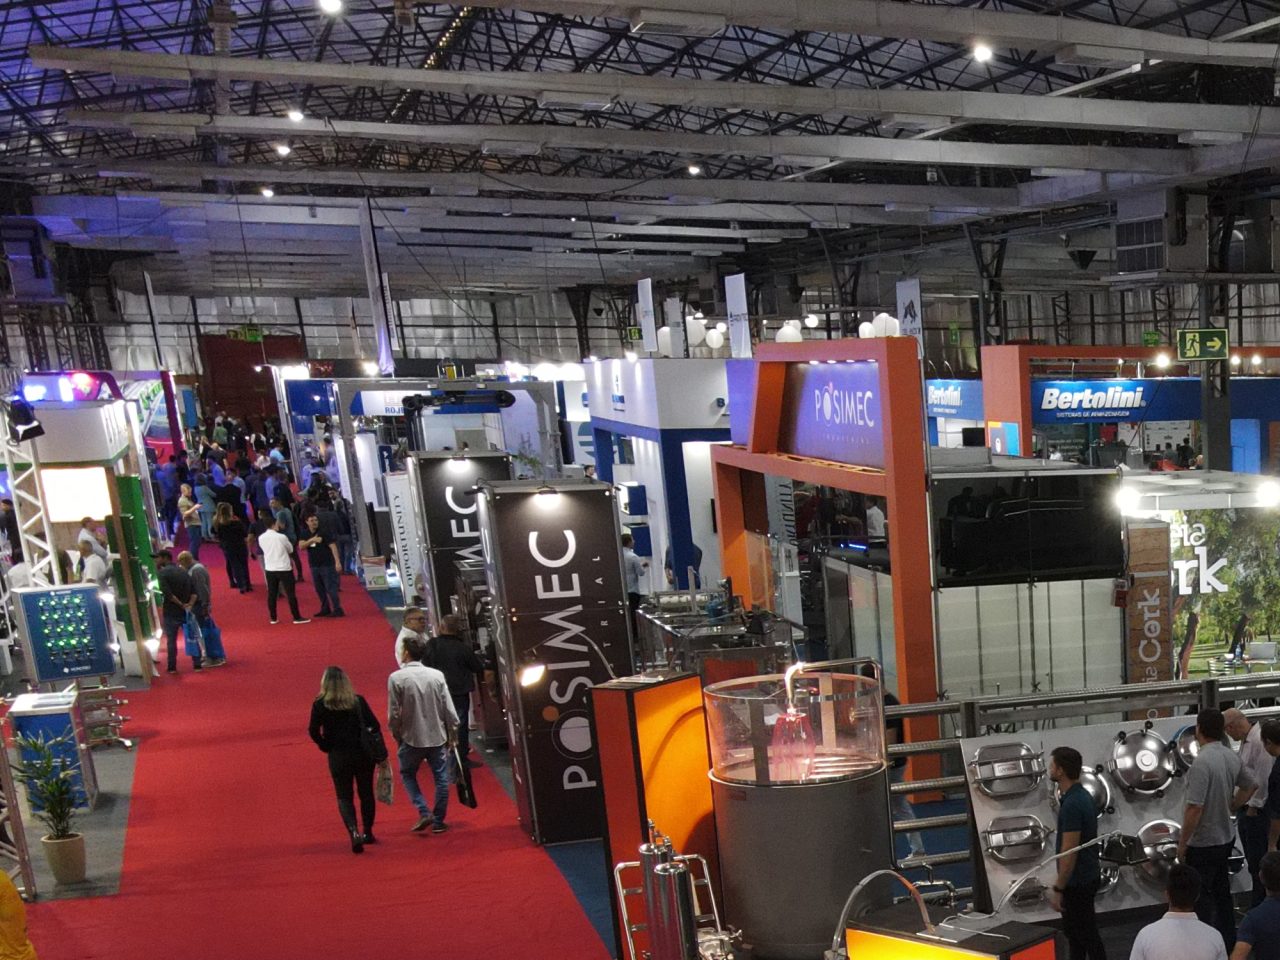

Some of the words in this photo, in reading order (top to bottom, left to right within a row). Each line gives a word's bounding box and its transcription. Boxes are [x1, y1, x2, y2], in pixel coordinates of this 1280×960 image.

[814, 386, 875, 427] POSIMEC
[928, 385, 962, 407] Bertolini
[1041, 386, 1144, 410] Bertolini
[1170, 546, 1229, 596] rk
[1137, 588, 1162, 664] Cork
[528, 530, 597, 790] POSIMEC
